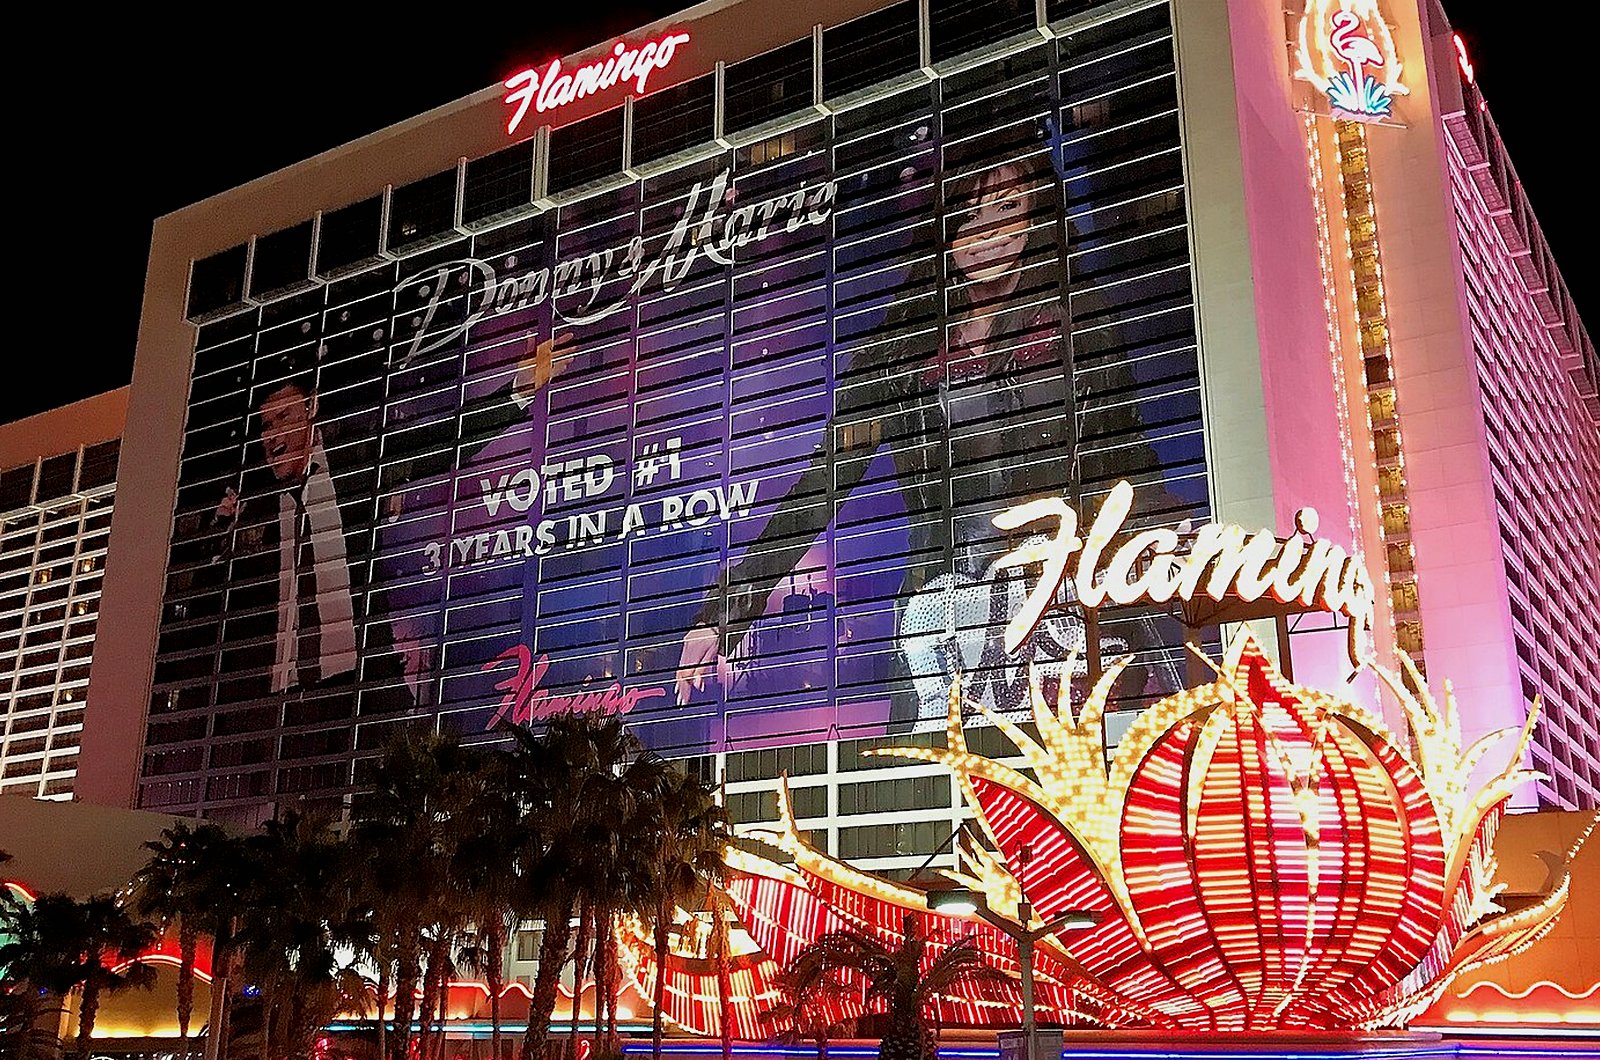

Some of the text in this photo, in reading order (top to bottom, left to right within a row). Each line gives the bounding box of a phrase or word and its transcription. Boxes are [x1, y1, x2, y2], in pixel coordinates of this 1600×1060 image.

[504, 33, 690, 135] Flamingo
[393, 247, 614, 370] Donny
[551, 166, 838, 326] Marie
[480, 436, 683, 517] VOTED #1
[422, 479, 760, 577] 3 YEARS IN A ROW
[990, 479, 1376, 678] Flaming
[480, 643, 667, 731] Flamingo
